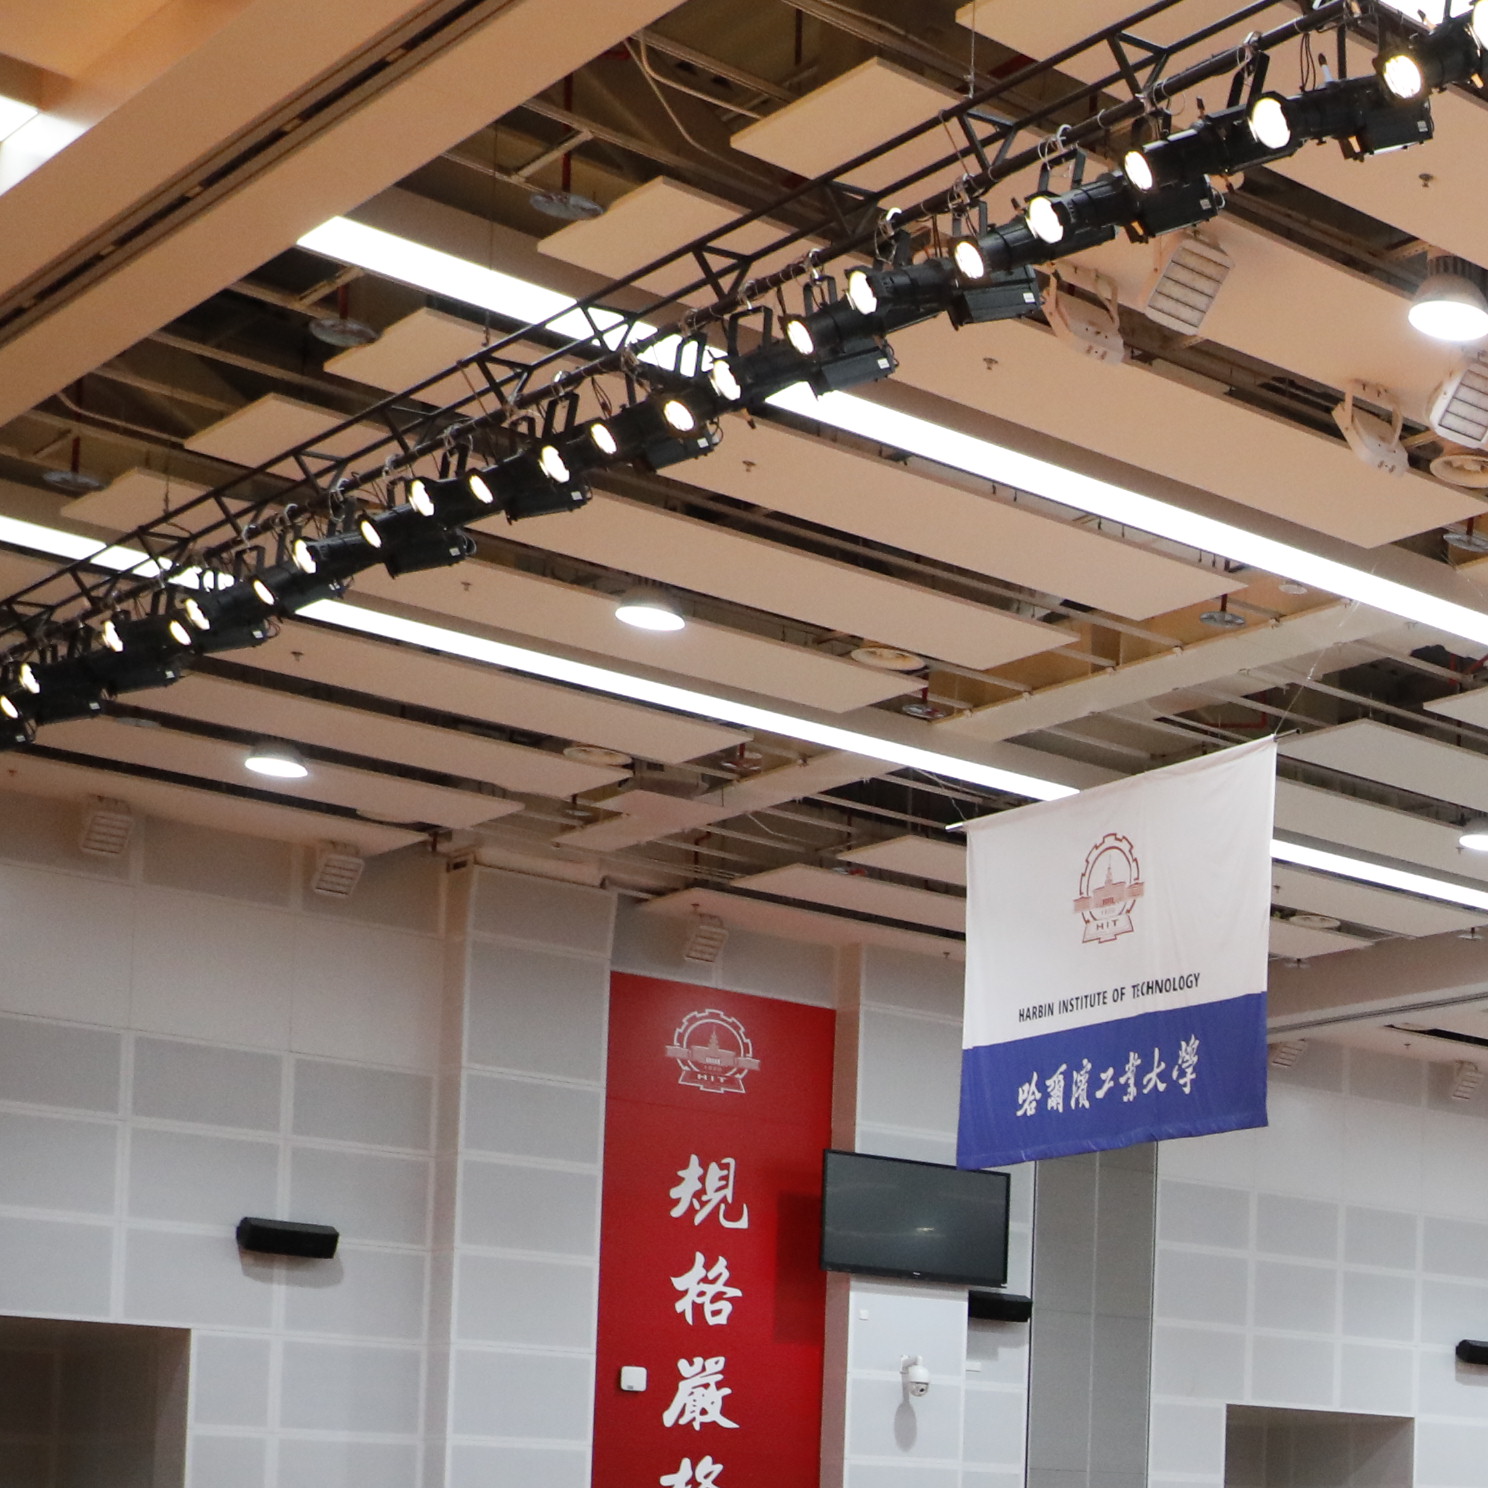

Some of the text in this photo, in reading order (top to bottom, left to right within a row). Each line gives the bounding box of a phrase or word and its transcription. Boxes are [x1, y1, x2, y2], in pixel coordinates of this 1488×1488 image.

[1096, 919, 1119, 931] HIT
[1018, 972, 1201, 1023] HARBIN INSTITUTE OF TECHNOLOGY
[697, 1074, 726, 1083] HIT
